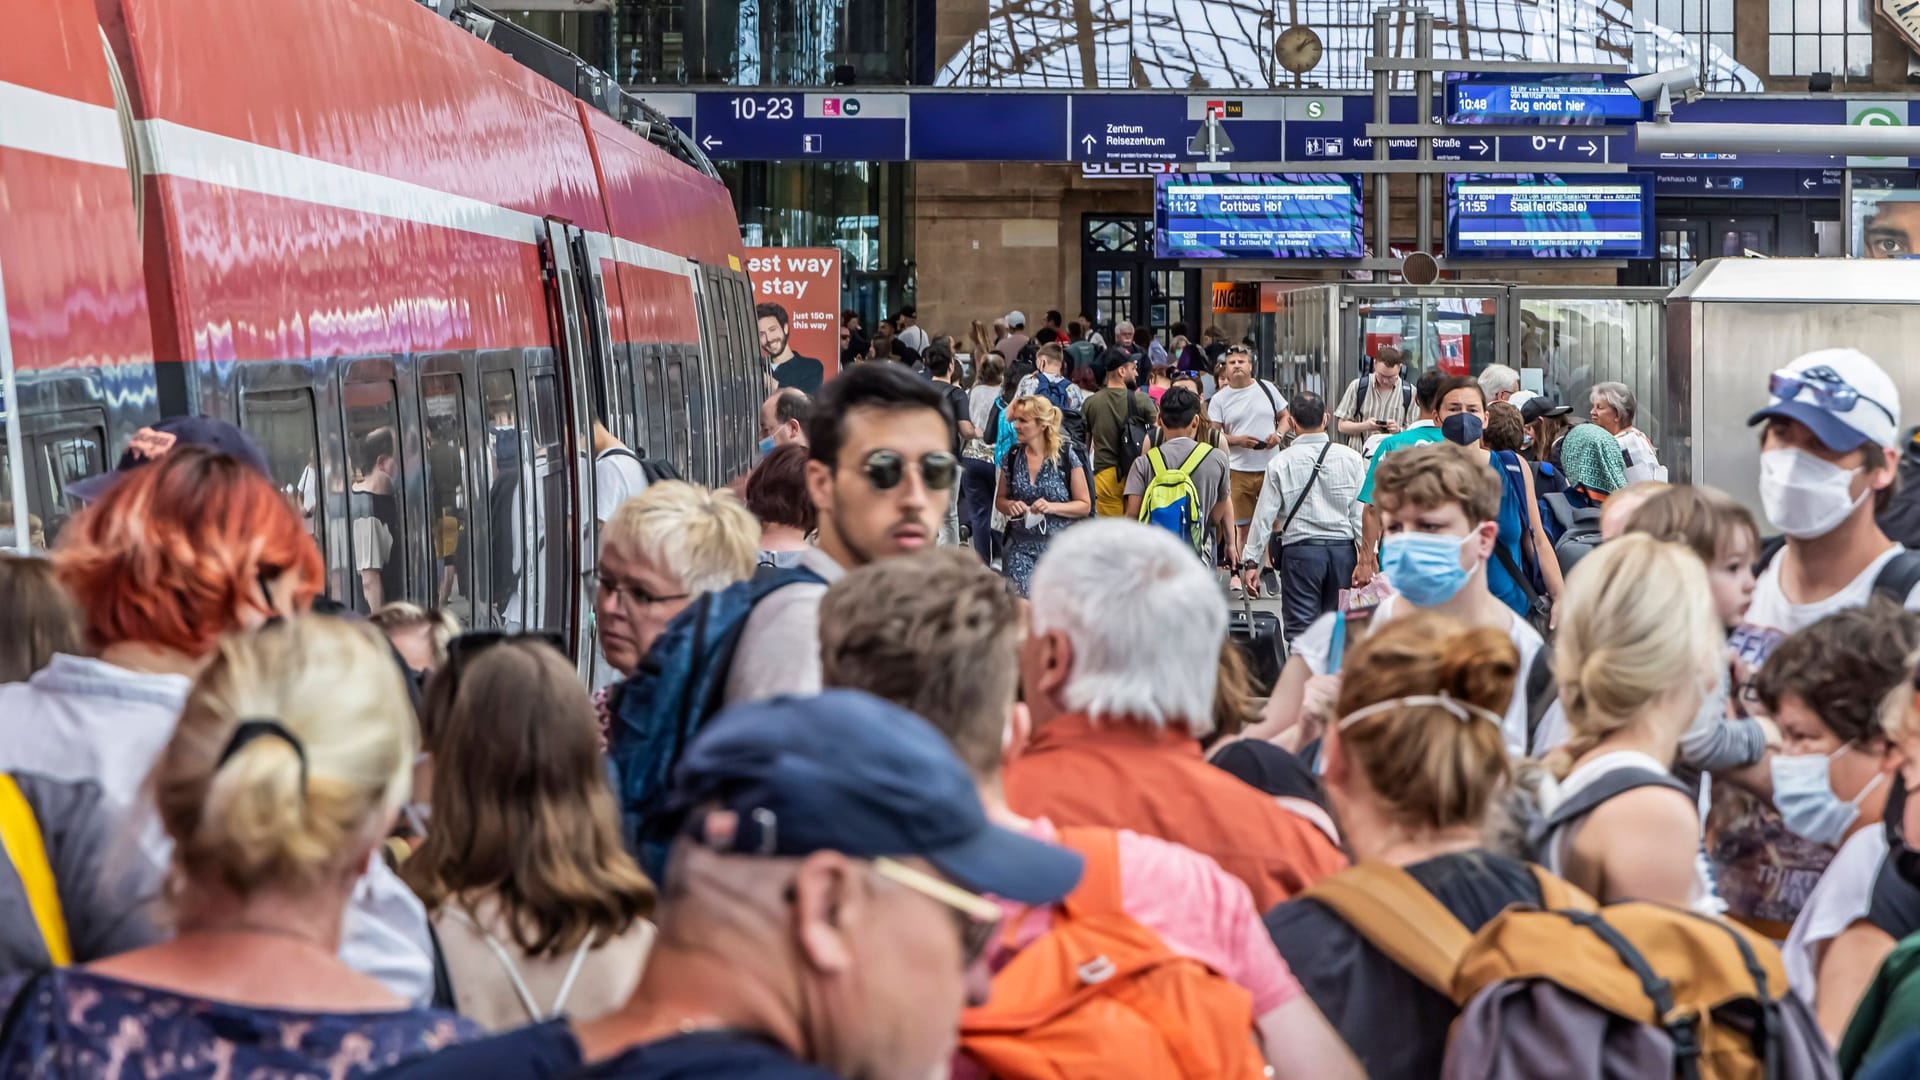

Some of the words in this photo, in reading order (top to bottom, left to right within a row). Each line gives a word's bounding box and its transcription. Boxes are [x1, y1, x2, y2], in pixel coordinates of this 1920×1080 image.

[731, 97, 794, 119] 10-23
[1227, 105, 1241, 113] TAXI
[1459, 99, 1487, 111] 10:48
[1510, 100, 1529, 112] Zug
[1533, 99, 1564, 111] endet
[1565, 99, 1585, 111] hier
[1106, 123, 1143, 134] Zentrum
[1106, 135, 1165, 146] Reisezentrum
[1657, 175, 1685, 184] Parkhaus
[1686, 175, 1697, 183] Ost
[1169, 201, 1197, 212] 11:12
[1220, 201, 1261, 212] Cottbus
[1264, 201, 1282, 212] Hbf
[1459, 202, 1487, 213] 11:55
[1510, 202, 1588, 213] Saalfeld(Saale)
[747, 254, 781, 273] est
[787, 257, 833, 278] way
[762, 277, 808, 299] stay
[1215, 289, 1249, 307] INGER
[793, 311, 808, 320] just
[810, 311, 824, 320] 150
[793, 321, 809, 329] this
[809, 323, 828, 331] way
